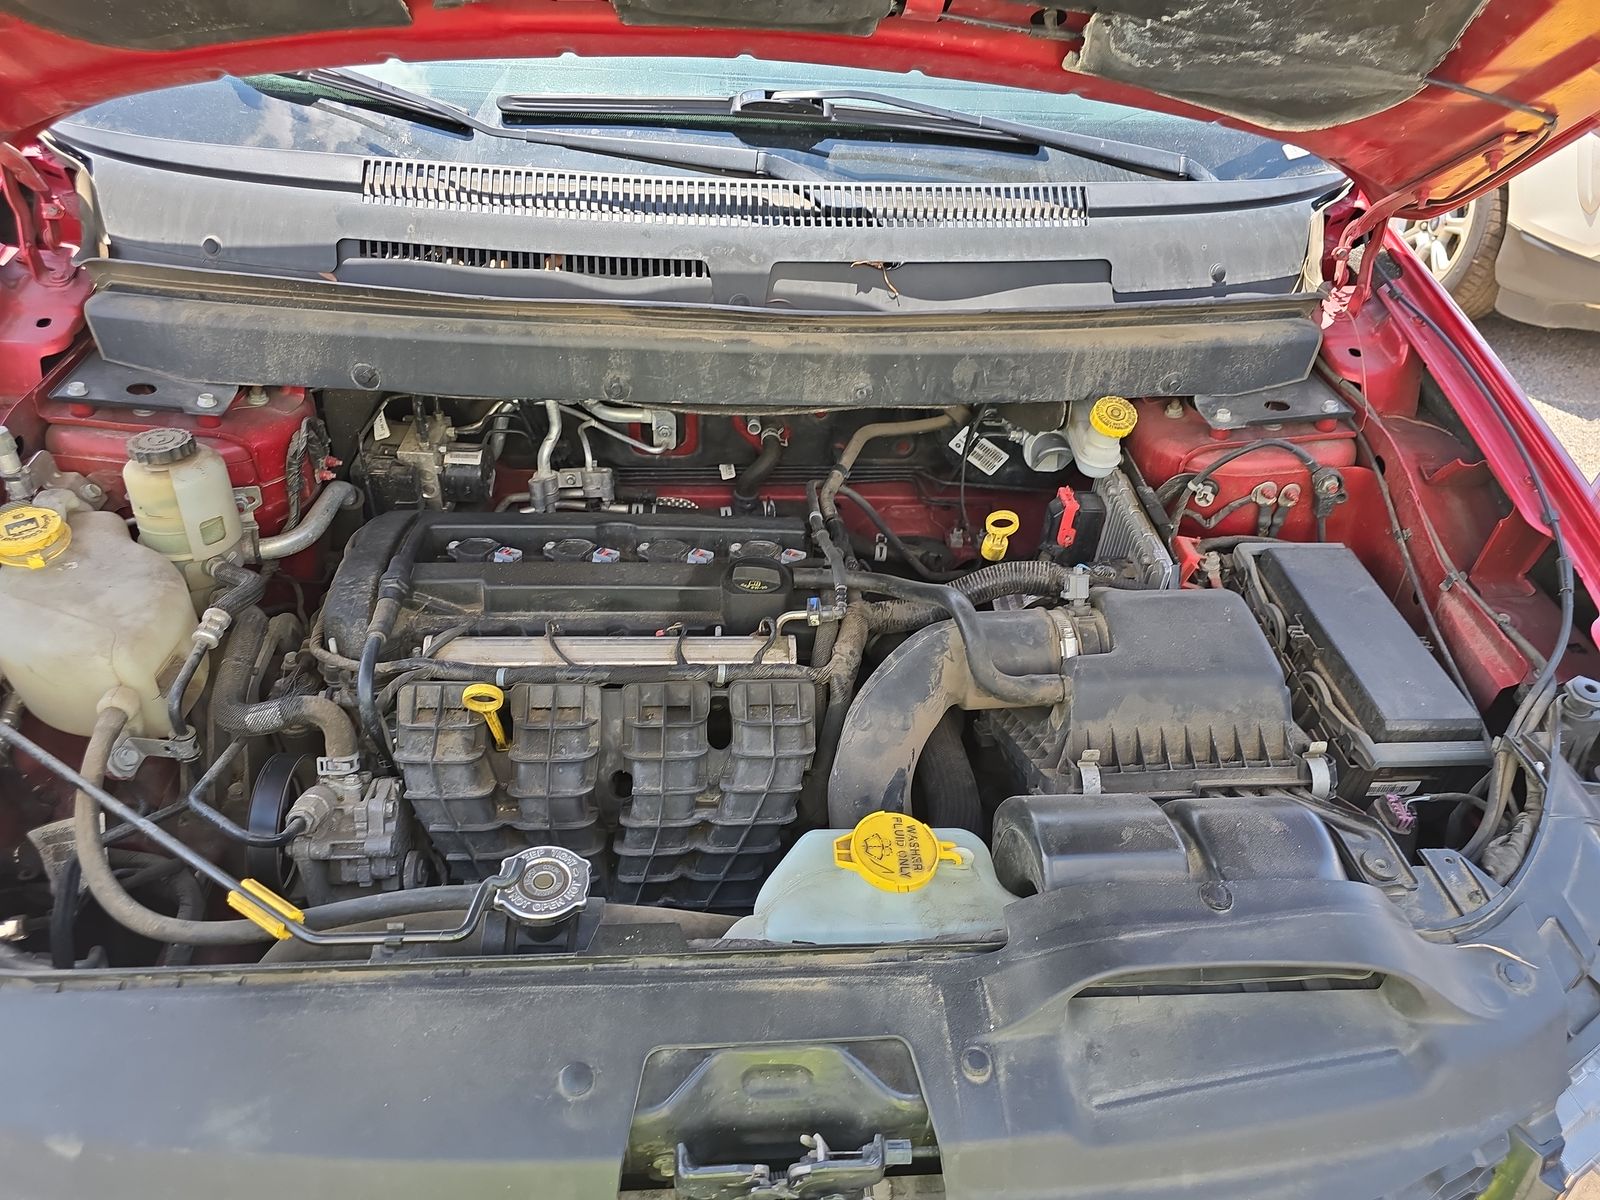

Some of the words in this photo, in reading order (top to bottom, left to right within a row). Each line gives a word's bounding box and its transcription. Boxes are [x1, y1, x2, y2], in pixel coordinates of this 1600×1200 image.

[892, 816, 906, 847] FLUID
[551, 849, 578, 867] TIGHT
[906, 824, 923, 873] WASHER
[897, 851, 912, 879] ONLY
[508, 892, 531, 909] NOT
[532, 898, 565, 912] OPEN
[564, 880, 582, 901] HOT
